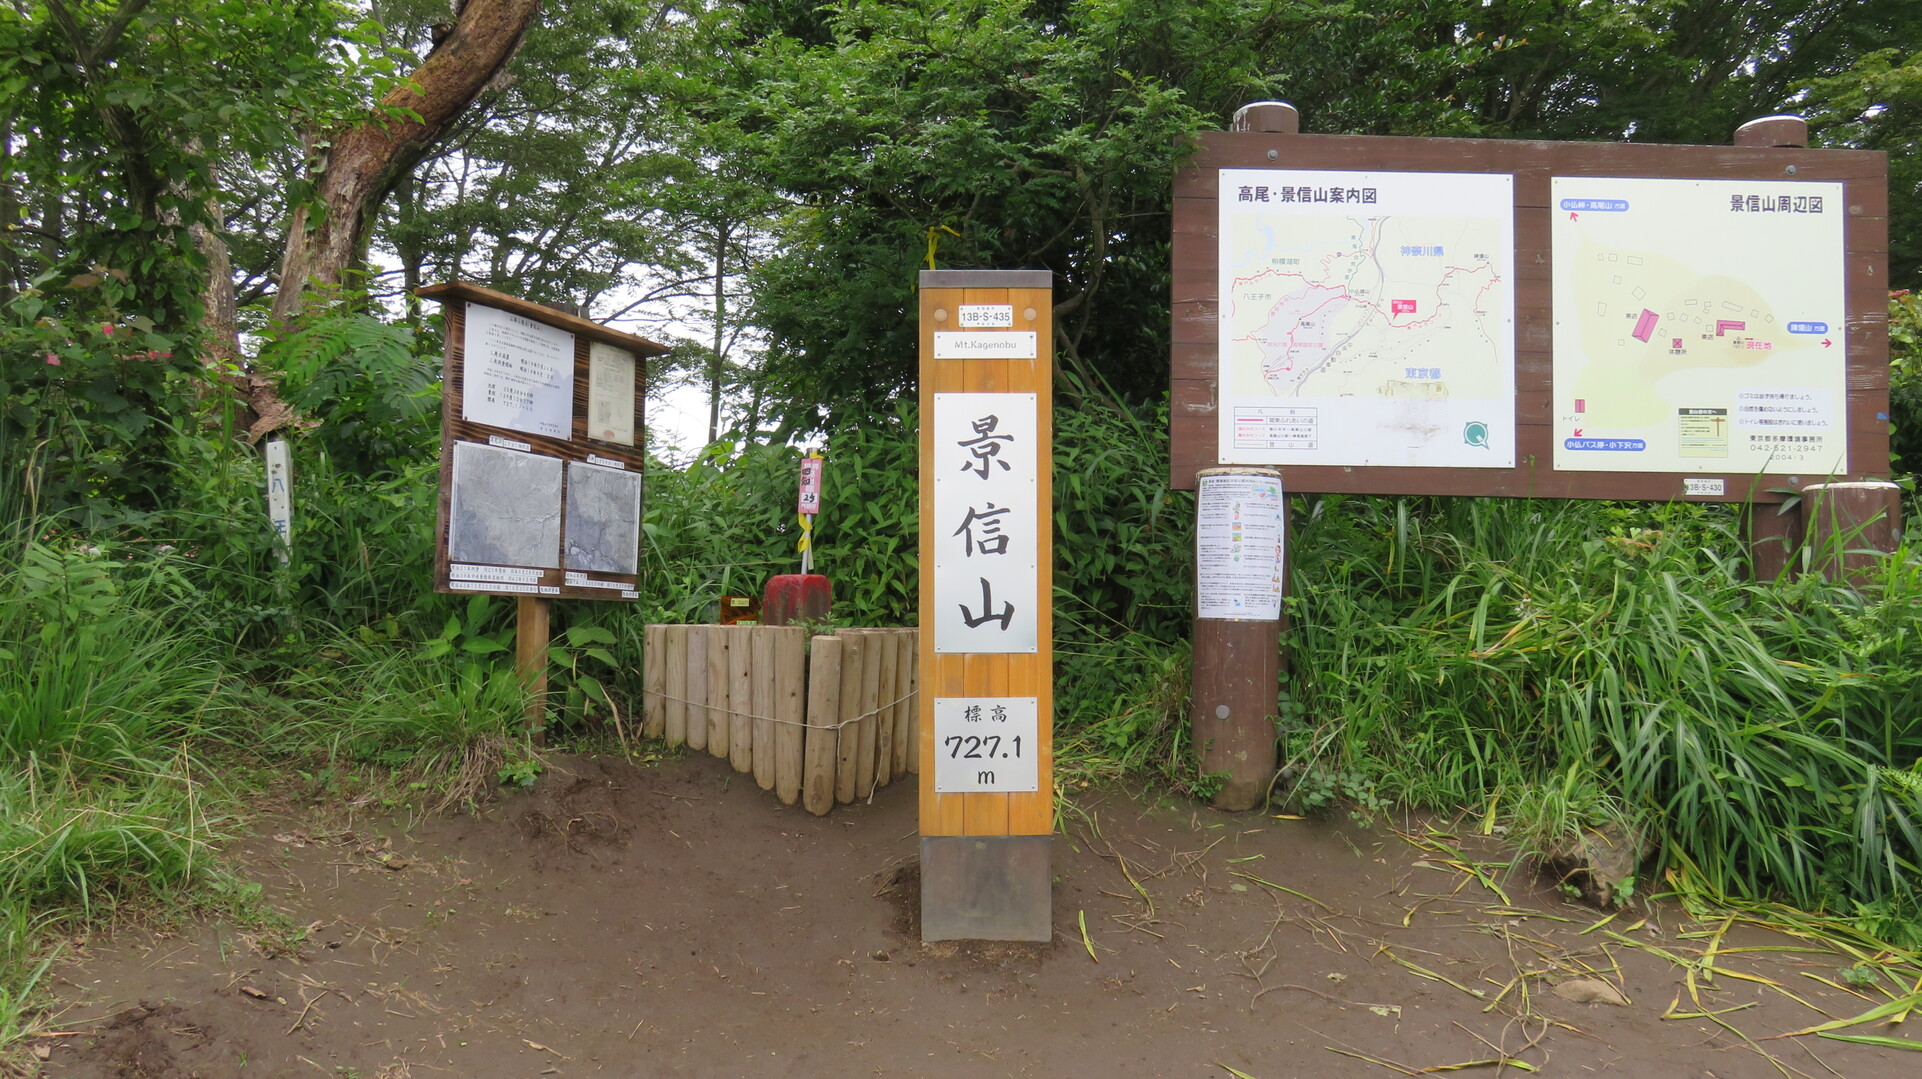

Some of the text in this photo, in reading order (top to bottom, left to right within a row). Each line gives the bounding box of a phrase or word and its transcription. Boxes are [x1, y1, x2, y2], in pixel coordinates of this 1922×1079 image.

[1238, 186, 1377, 204] 高尾・景信山案内図
[1730, 194, 1823, 214] 景信山周辺図
[1400, 246, 1444, 256] 神奈川県
[961, 312, 1010, 322] 13B-S-435
[954, 340, 1017, 350] Mt.Kagenobu
[1746, 341, 1772, 350] 現在地
[1405, 368, 1441, 379] 東京都
[952, 413, 1015, 631] 景信山
[964, 705, 1008, 723] 標高
[944, 735, 1022, 759] 727.1
[977, 770, 995, 785] m
